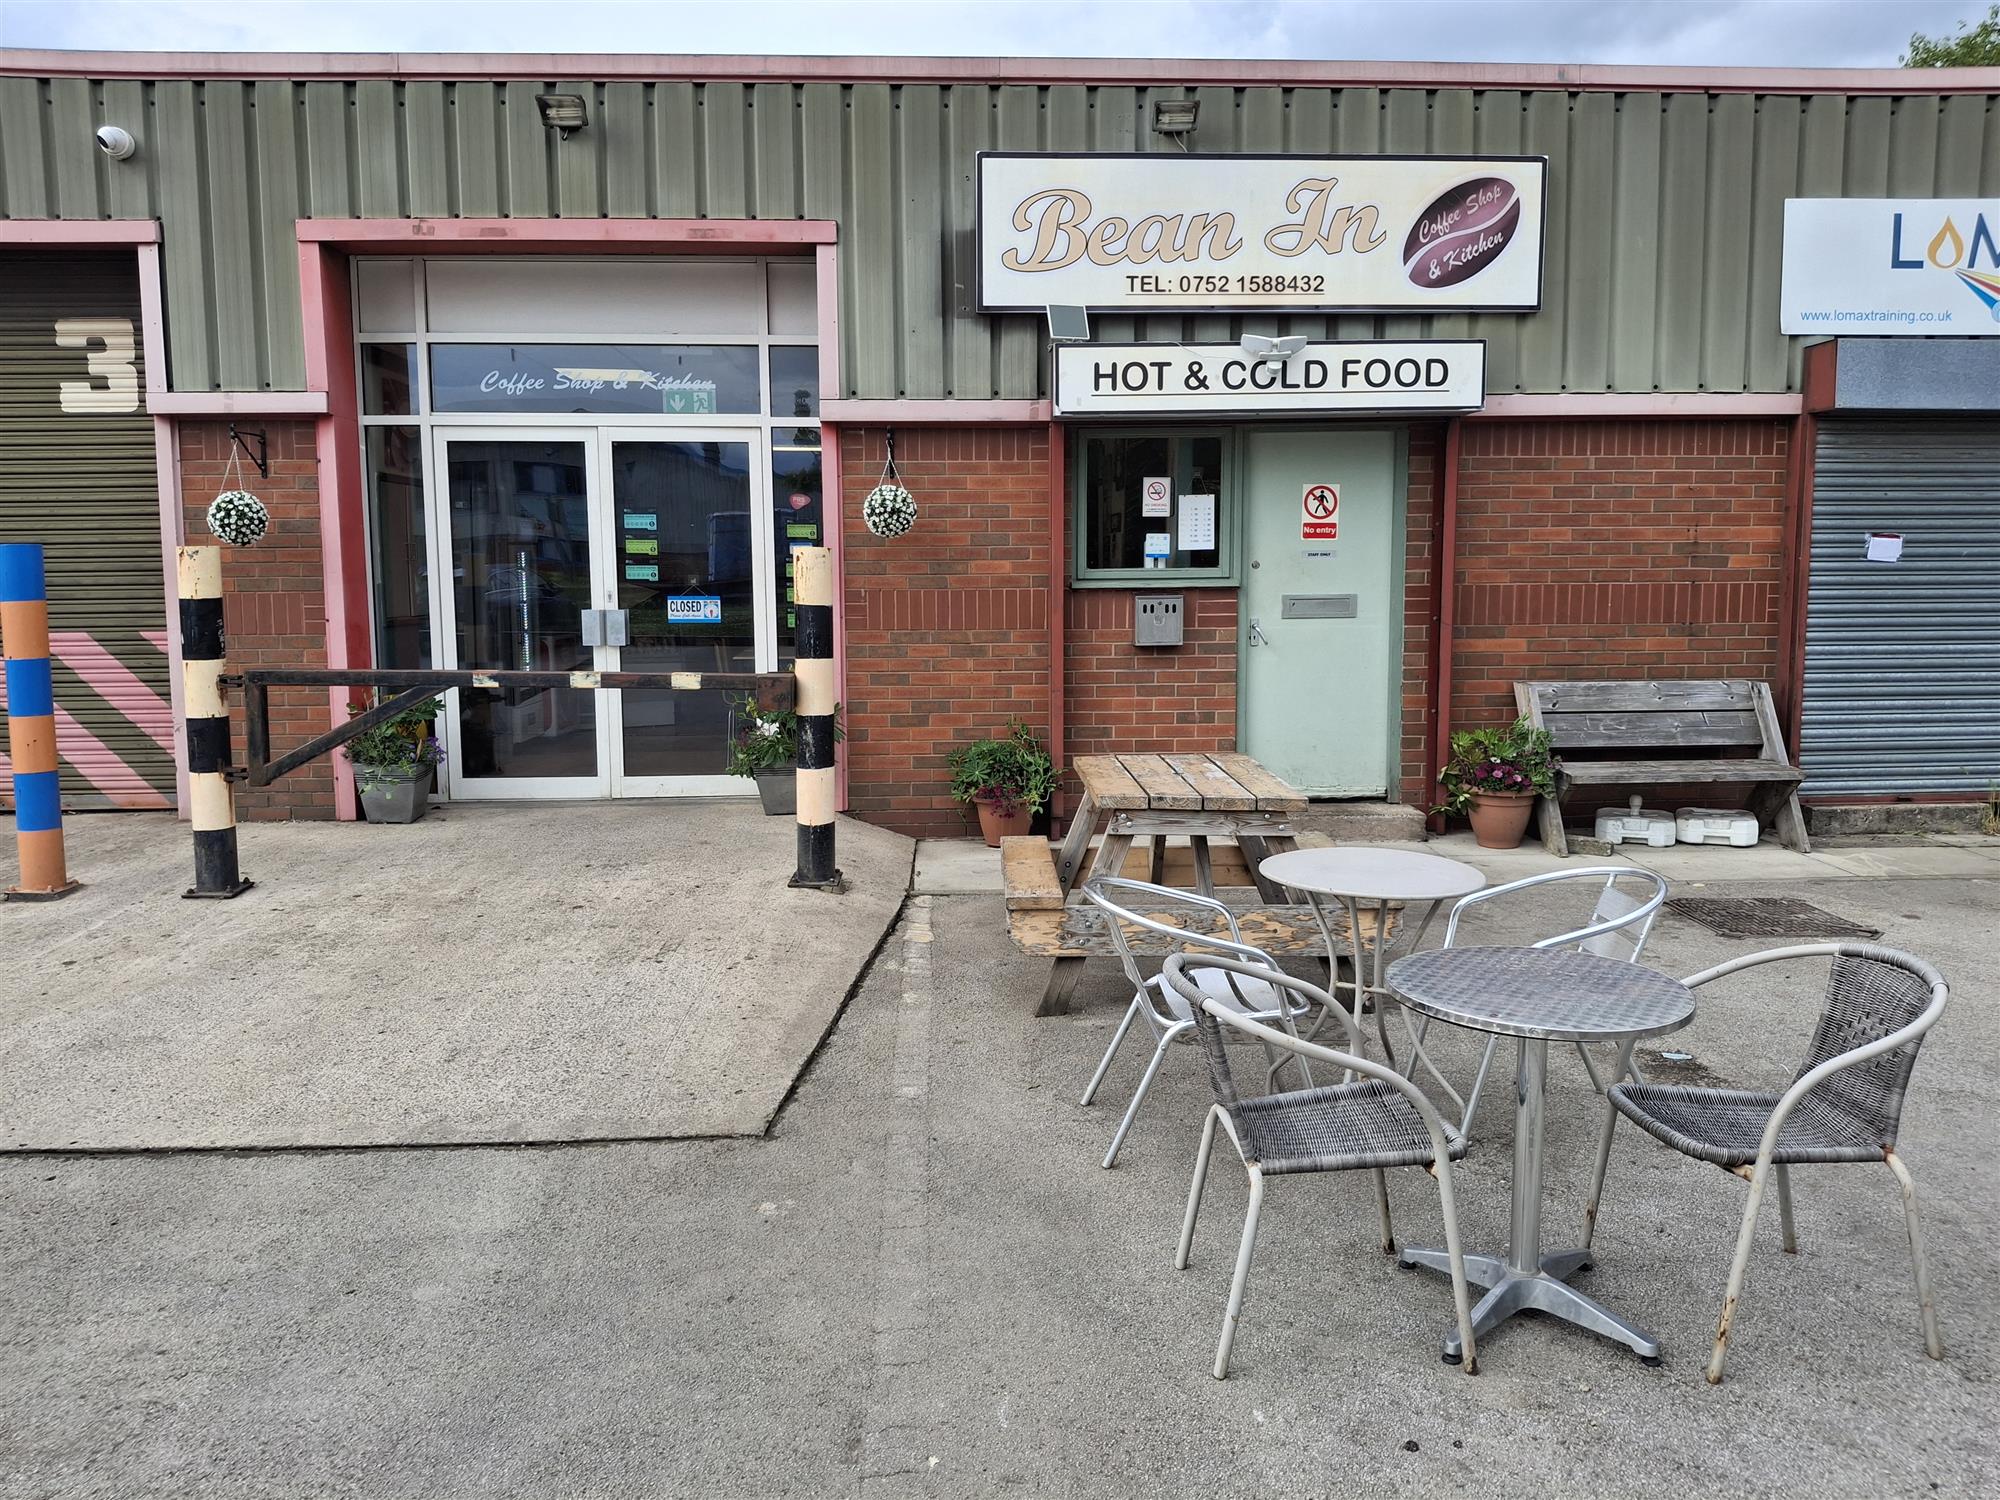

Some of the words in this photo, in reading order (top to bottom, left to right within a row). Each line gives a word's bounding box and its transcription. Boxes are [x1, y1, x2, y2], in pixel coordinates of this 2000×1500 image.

[1001, 188, 1243, 273] Bean
[1263, 177, 1388, 257] In
[1419, 209, 1462, 243] Coffee
[1466, 185, 1502, 215] Shop
[1428, 258, 1442, 280] &
[1443, 232, 1504, 271] Kitchen
[1125, 275, 1172, 292] TEL:
[1180, 275, 1230, 292] 0752
[1236, 275, 1326, 292] 1588432
[1800, 309, 1953, 325] www.lomaxtraining.co.uk
[54, 317, 139, 413] 3
[1093, 361, 1173, 392] HOT
[1183, 360, 1211, 391] &
[1221, 359, 1329, 391] COLD
[1340, 357, 1450, 389] FOOD
[480, 370, 546, 396] Coffee
[553, 371, 605, 394] Shop
[613, 370, 629, 391] &
[640, 370, 713, 391] Kitchen
[1303, 526, 1315, 534] No
[1316, 526, 1337, 535] entry
[669, 600, 702, 613] CLOSED
